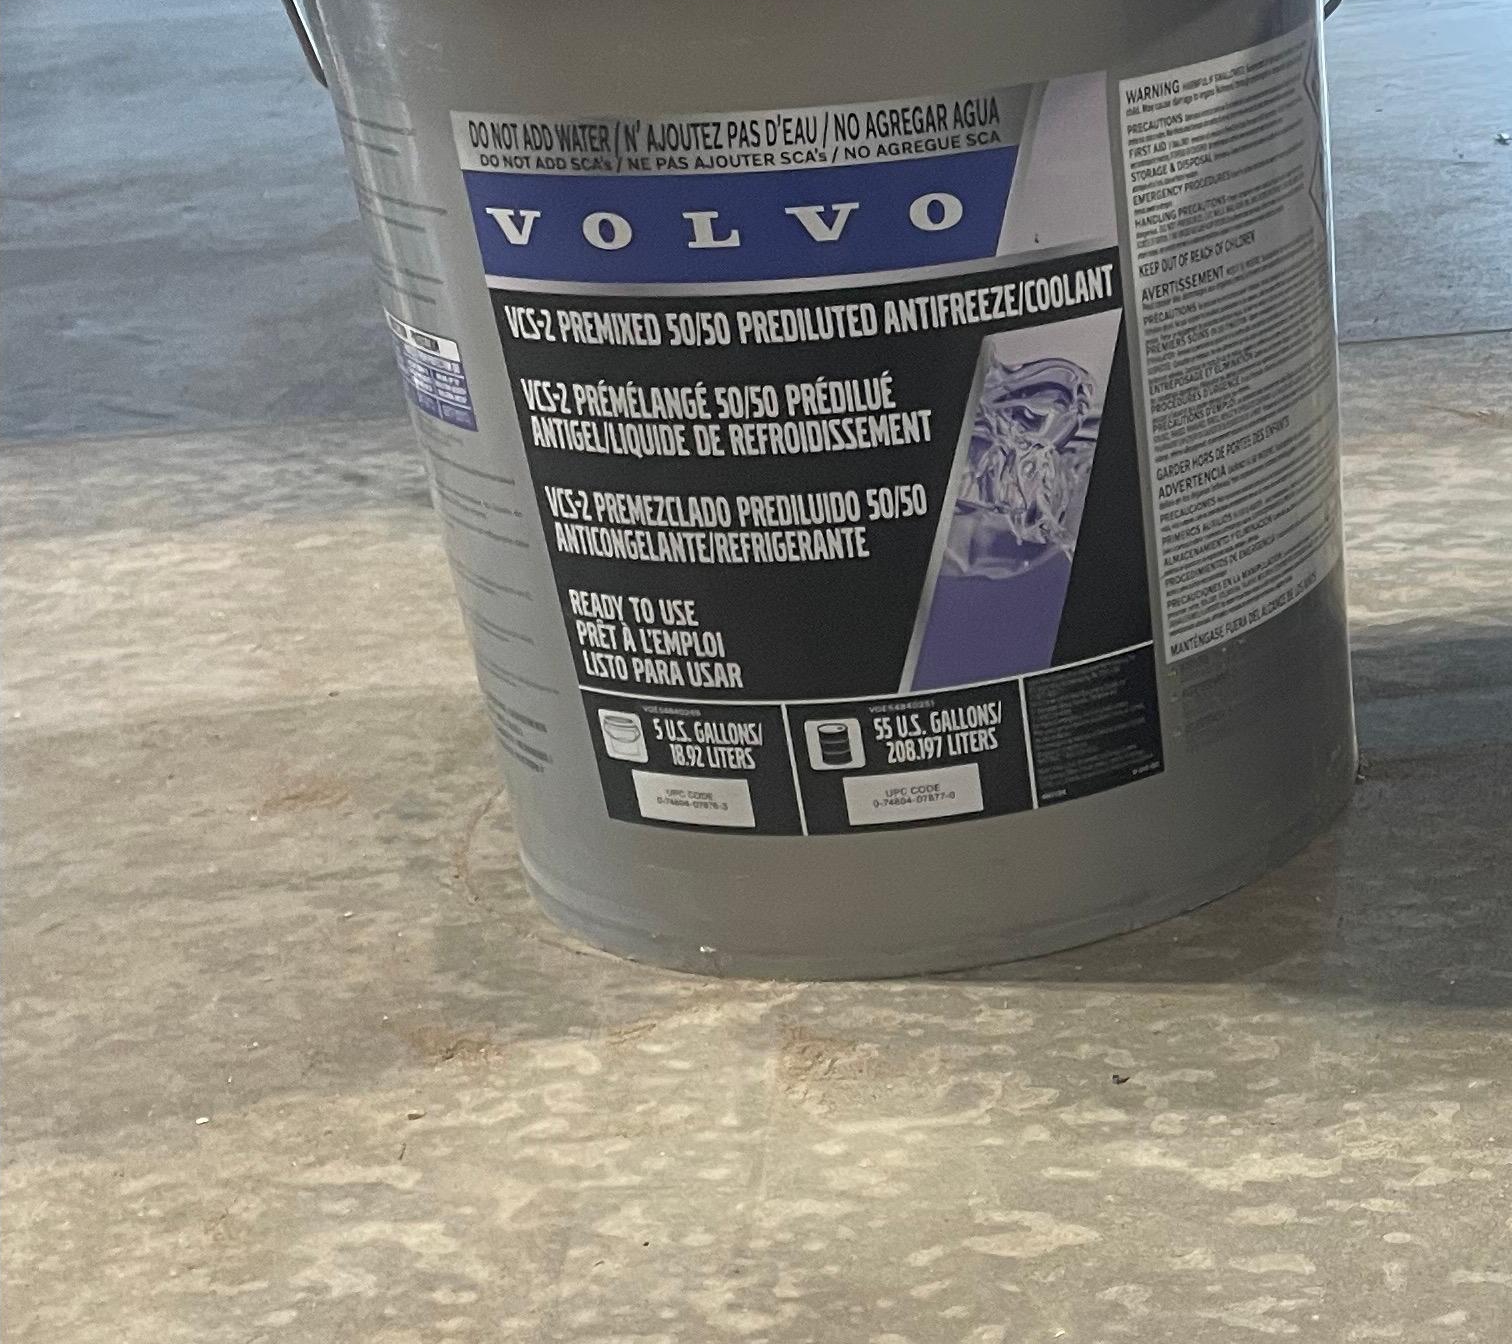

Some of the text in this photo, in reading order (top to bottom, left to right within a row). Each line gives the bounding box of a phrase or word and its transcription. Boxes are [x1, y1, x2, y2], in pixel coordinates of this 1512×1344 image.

[1126, 79, 1180, 105] WARNING
[468, 120, 488, 148] DO
[491, 121, 518, 150] NOT
[523, 123, 554, 151] ADD
[555, 124, 611, 153] WATER
[647, 121, 723, 152] AJOUTEZ
[727, 119, 761, 149] PAS
[765, 114, 818, 147] D'EAU
[834, 112, 860, 141] NO
[866, 103, 950, 138] AGREGAR
[953, 96, 1000, 128] AGUA
[1127, 113, 1183, 135] PRECAUTIONS
[480, 154, 498, 167] DO
[501, 155, 532, 169] NOT
[535, 156, 567, 170] ADD
[628, 157, 652, 171] NE
[656, 156, 688, 171] PAS
[694, 153, 776, 169] AJOUTER
[845, 145, 871, 160] NO
[876, 134, 961, 157] AGREGUE
[966, 130, 1001, 145] SCA
[485, 192, 963, 250] VOLVO
[1142, 265, 1225, 303] AVERTISSEMENT
[504, 264, 1114, 346] VCS-2 PREMIXED 50/50 PREDILUTED ANTIFREEZE/COOLANT
[520, 371, 896, 420] VCS-2 PRÉMÉLANGÉ 50/50 PRÉDILUÉ
[530, 410, 932, 458] ANTIGEL/LIQUIDE DE REFROIDISSEMENT
[1159, 465, 1227, 499] ADVERTENCIA
[544, 484, 928, 528] VCS-2 PREMEZCLADO PREDILUIDO 50/50
[554, 522, 870, 564] ANTICONGELANTE/REFRIGERANTE
[568, 588, 699, 627] READY TO USE
[576, 619, 726, 658] PRÊT À L'EMPLOI
[582, 649, 744, 688] LISTO PARA USAR
[653, 718, 763, 746] 5 U.S. GALLONS/
[873, 701, 1003, 741] 55 U.S. GALLONS/
[670, 744, 756, 769] 18.92 LITERS
[886, 728, 998, 764] 208.197 LITERS
[885, 783, 941, 798] UPC CODE
